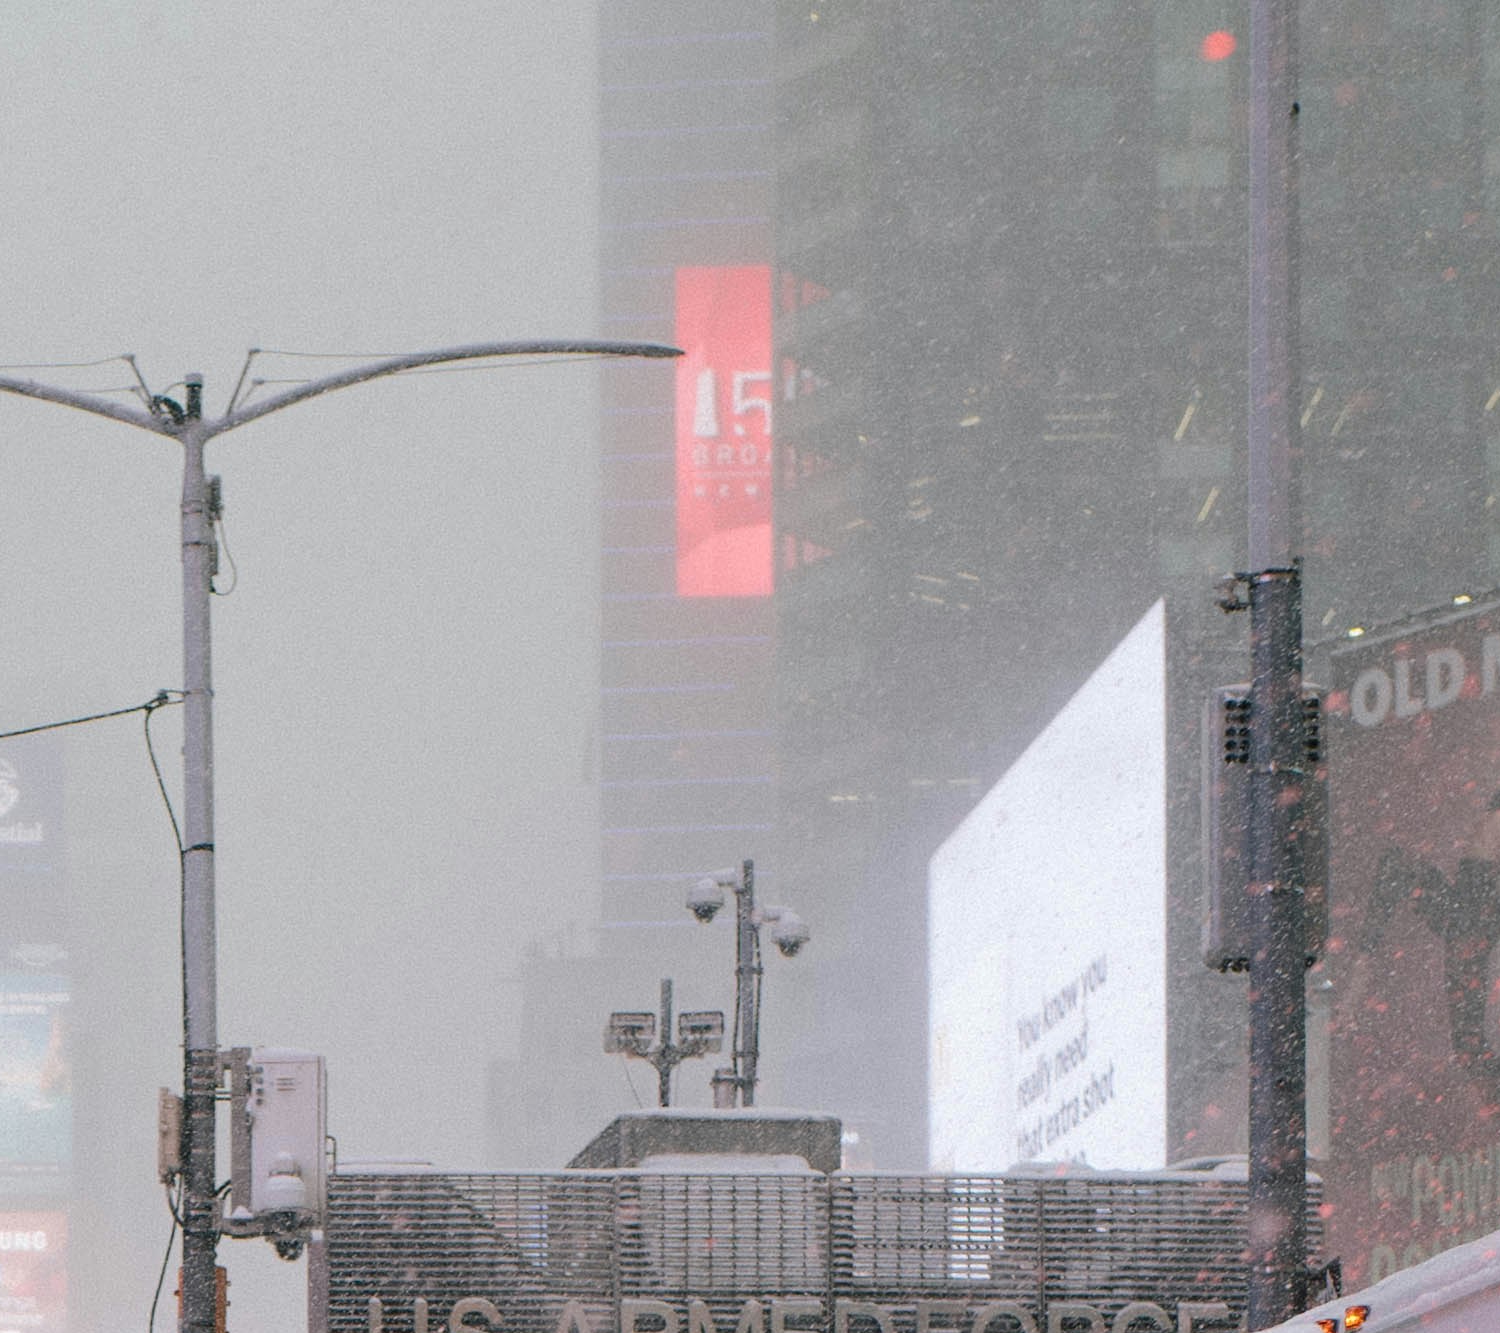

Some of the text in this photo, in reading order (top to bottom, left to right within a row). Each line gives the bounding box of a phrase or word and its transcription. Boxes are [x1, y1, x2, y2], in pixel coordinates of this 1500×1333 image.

[1351, 649, 1466, 727] OLD
[1055, 1020, 1088, 1081] need
[1046, 1096, 1080, 1145] extra
[1083, 1058, 1114, 1118] shot
